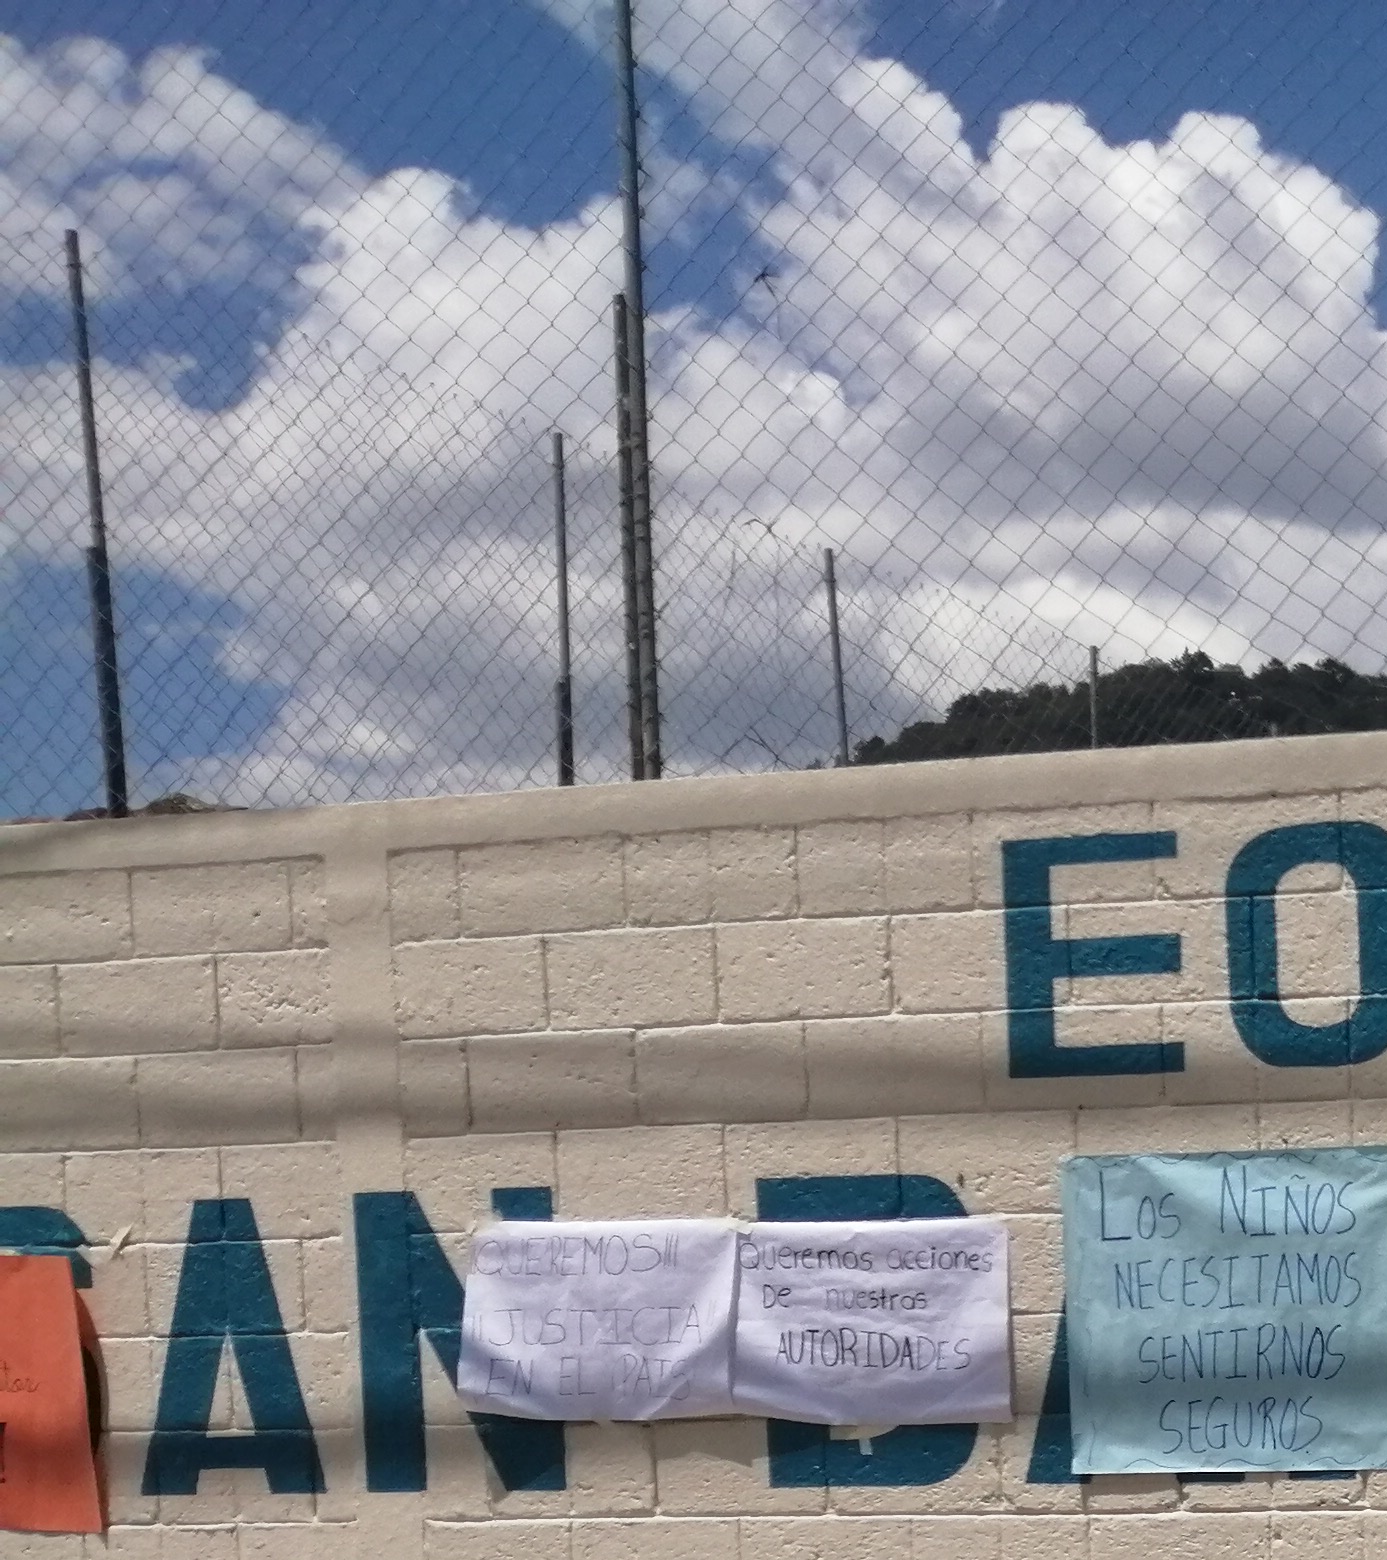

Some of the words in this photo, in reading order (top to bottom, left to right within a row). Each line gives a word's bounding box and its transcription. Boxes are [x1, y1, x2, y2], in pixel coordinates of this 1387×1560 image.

[737, 1240, 873, 1274] Queremos
[886, 1241, 993, 1273] acciones
[762, 1284, 792, 1310] De
[1113, 1251, 1363, 1311] NECESITAMOS
[776, 1327, 972, 1371] AUTORIDADES
[1137, 1322, 1346, 1384] SENTIRNOS
[485, 1357, 534, 1398] EN
[558, 1354, 597, 1397] EL
